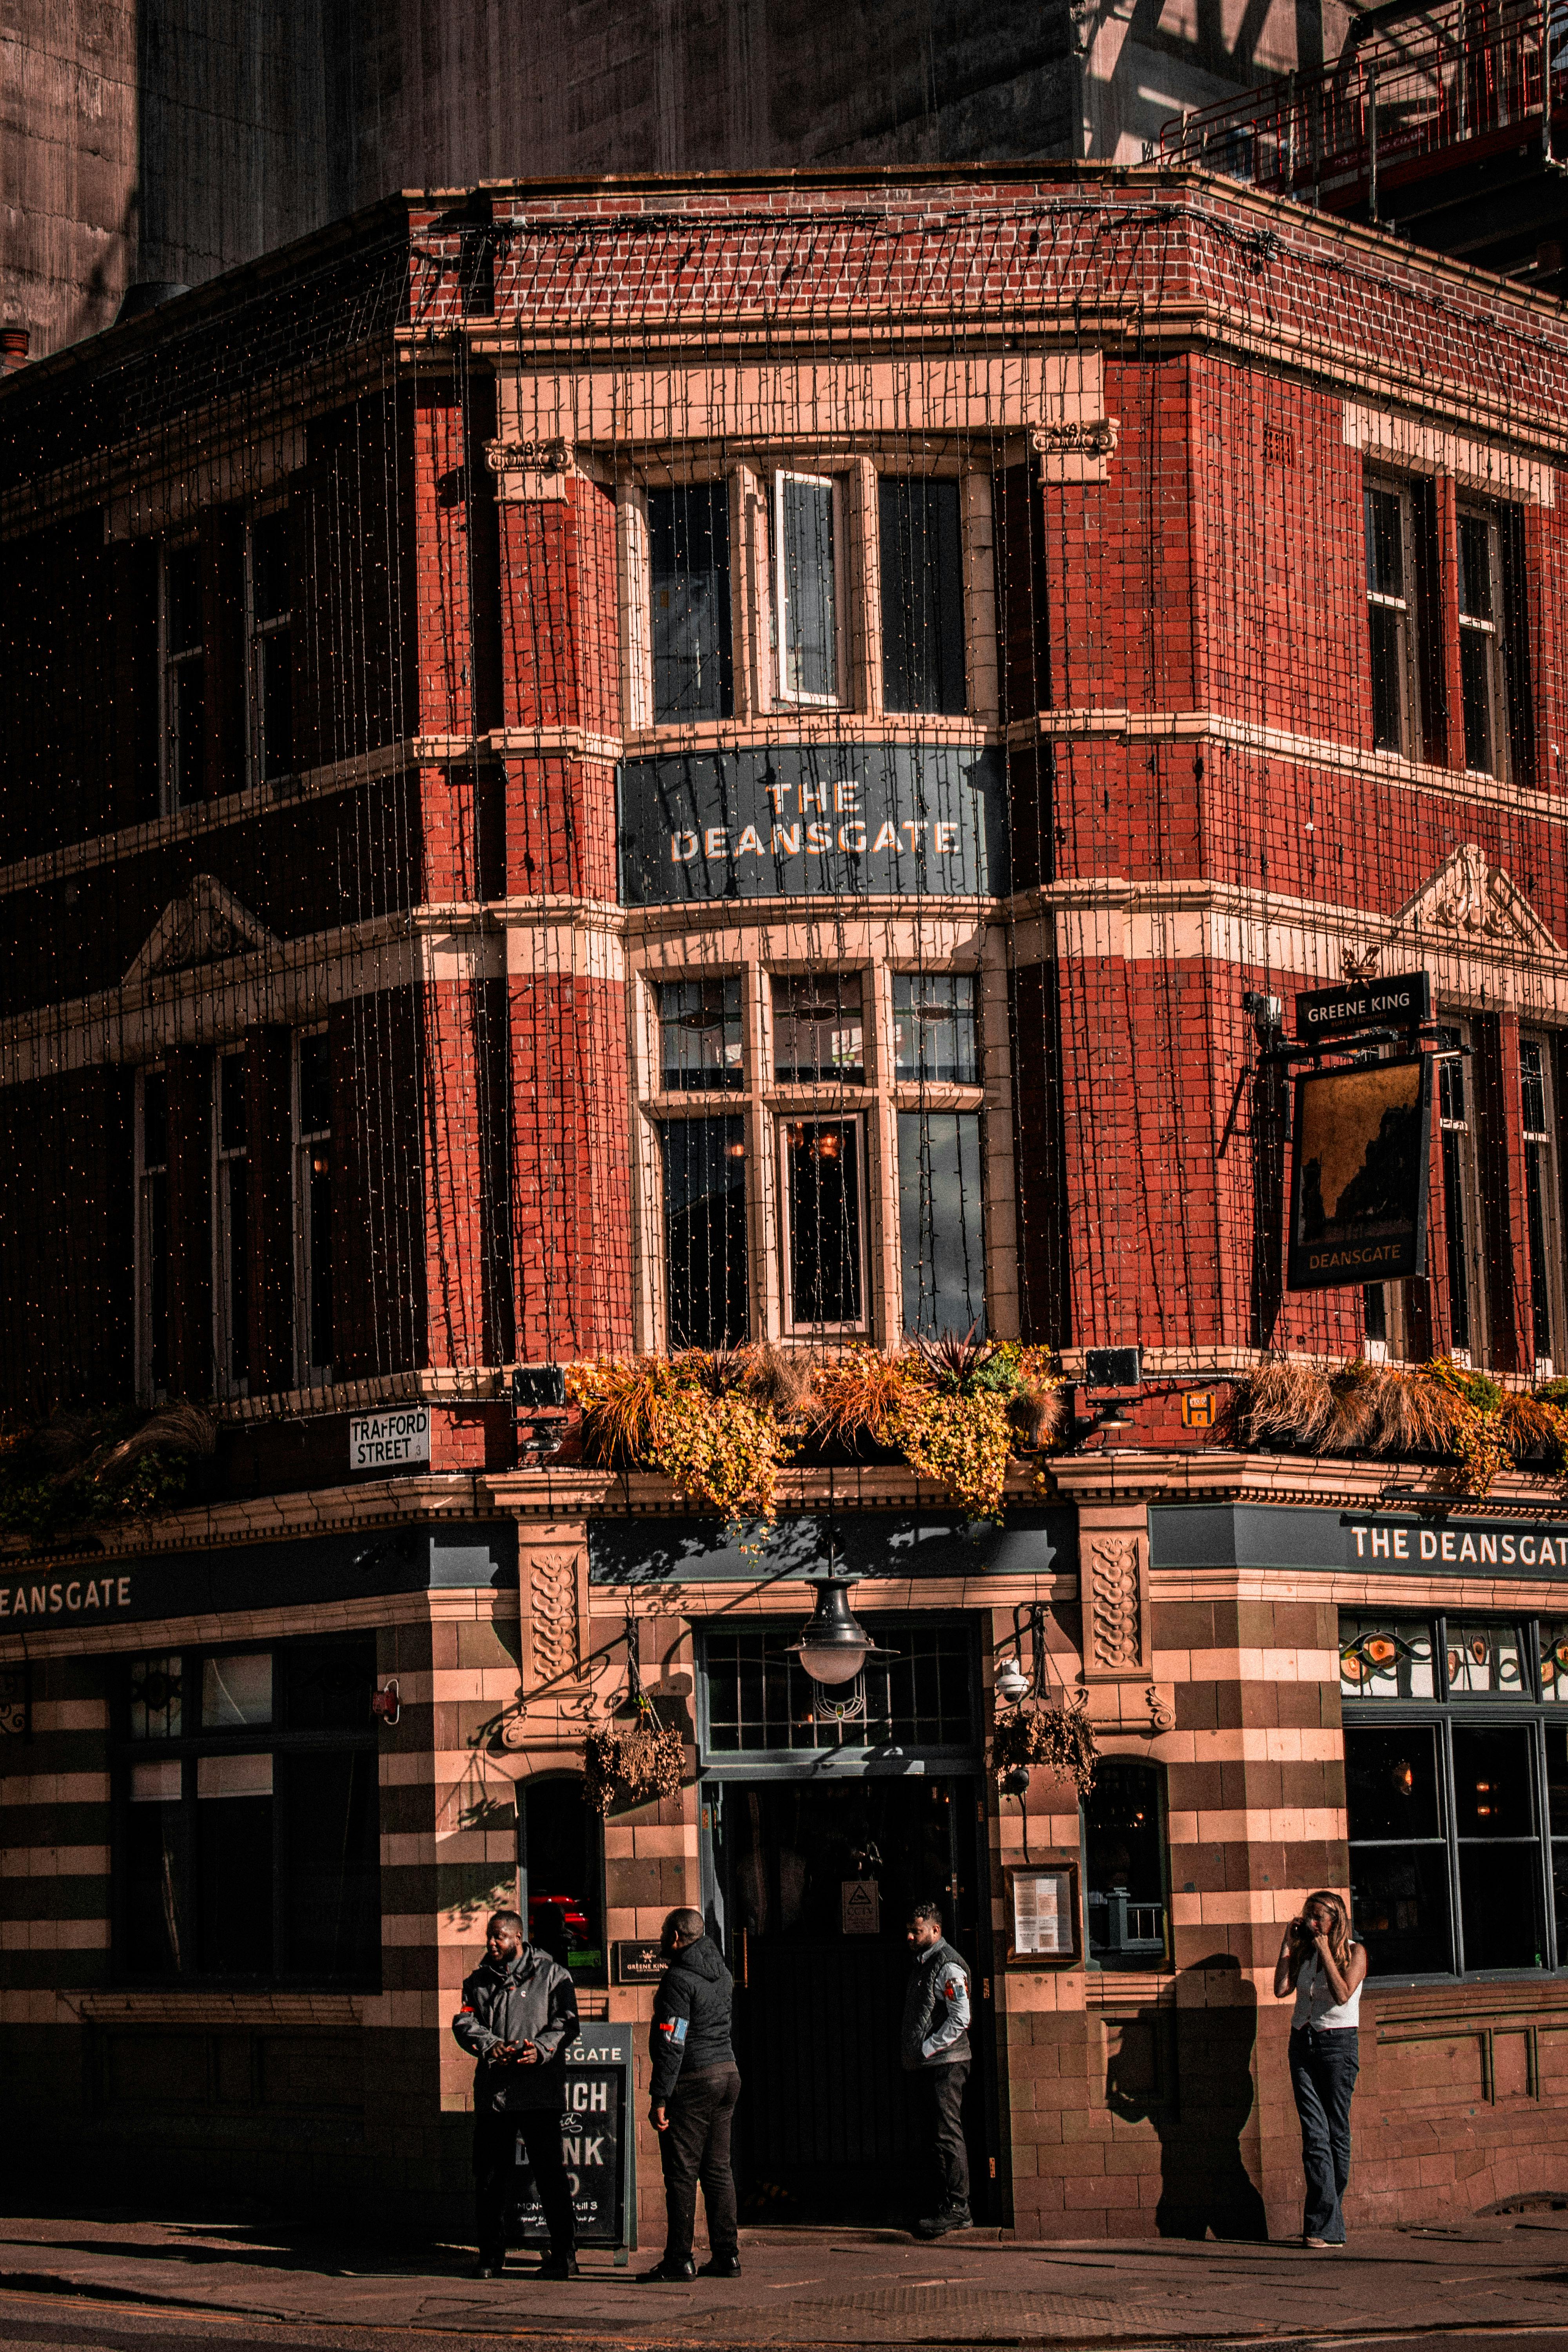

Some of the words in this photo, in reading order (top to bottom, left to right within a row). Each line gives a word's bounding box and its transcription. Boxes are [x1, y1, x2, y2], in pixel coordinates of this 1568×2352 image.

[766, 781, 863, 814] THE
[671, 820, 959, 862] DEANSGATE
[1308, 1000, 1366, 1022] GREENE
[1371, 993, 1410, 1012] KING
[1309, 1243, 1402, 1270] DEANSGATE
[1187, 1394, 1211, 1424] H
[352, 1413, 426, 1441] TRAFFORD
[358, 1437, 411, 1464] STREET
[1351, 1526, 1410, 1559] THE
[1420, 1530, 1568, 1566] DEANSGAT
[0, 1577, 131, 1616] EANSGATE
[515, 2136, 604, 2166] DNK
[517, 2202, 543, 2211] MON-
[590, 2201, 598, 2210] 3
